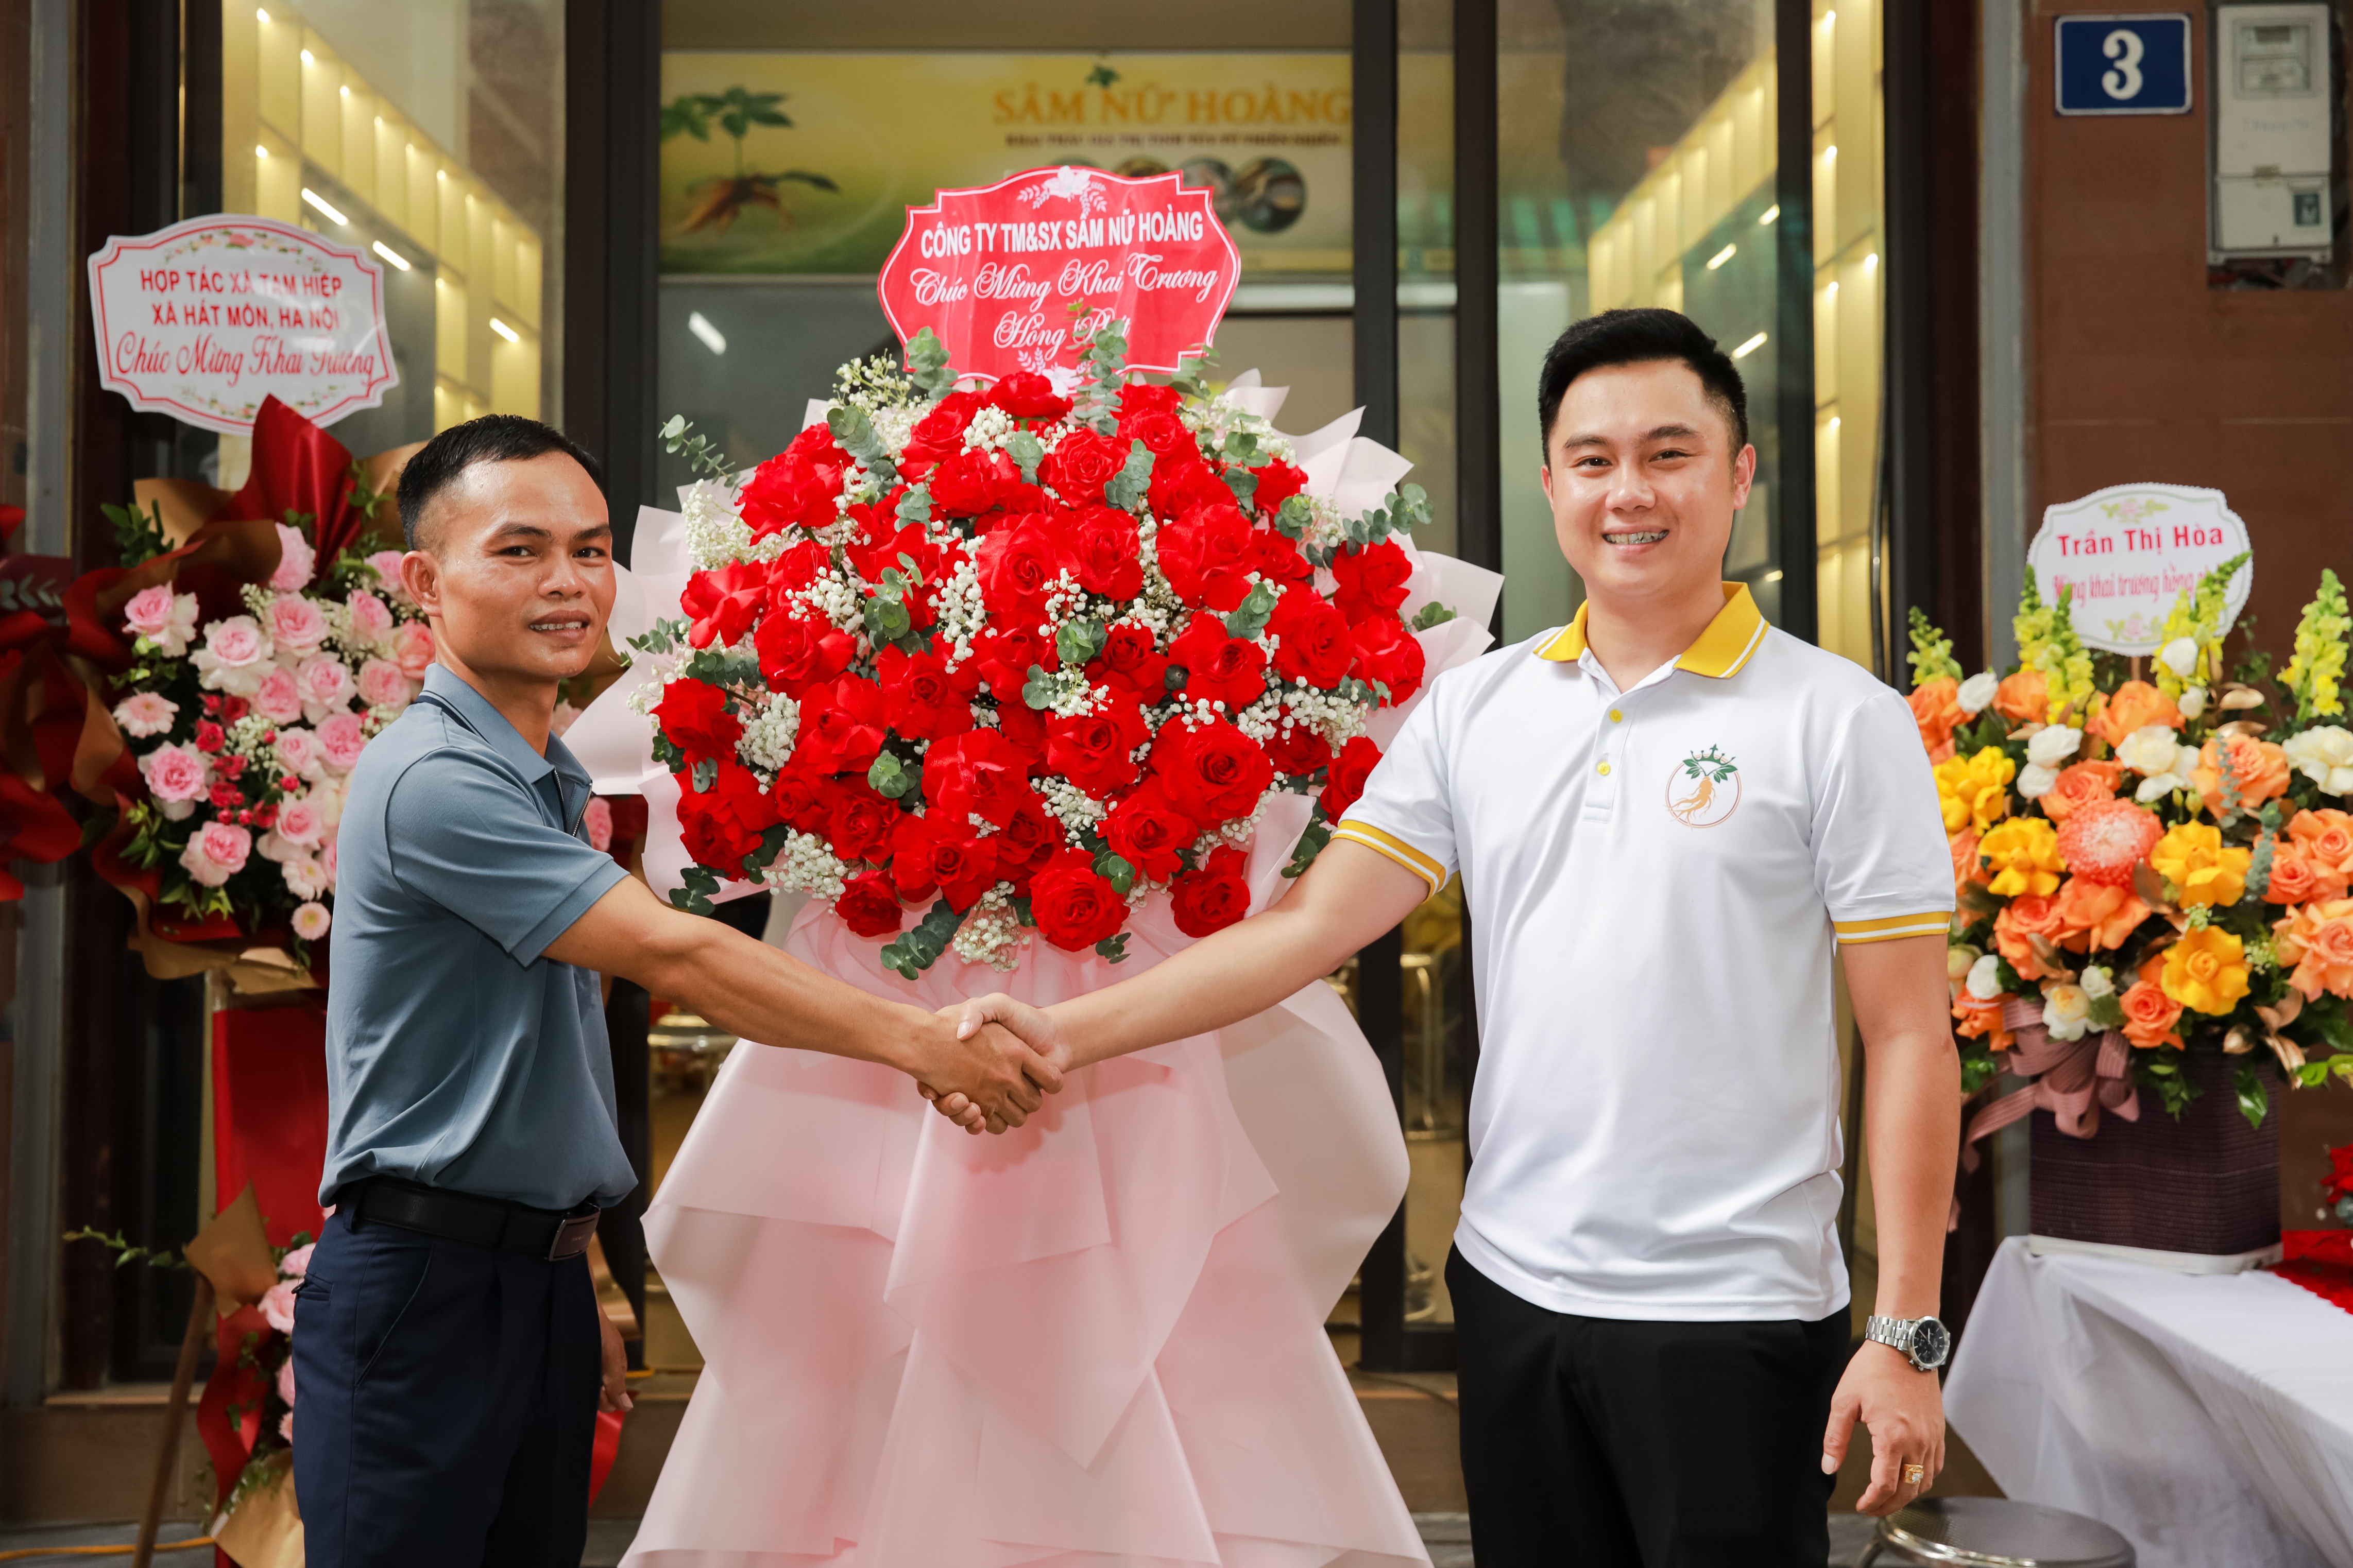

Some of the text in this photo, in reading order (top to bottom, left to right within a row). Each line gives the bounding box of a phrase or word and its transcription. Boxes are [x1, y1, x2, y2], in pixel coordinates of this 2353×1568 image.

[2102, 29, 2144, 100] 3
[1188, 82, 1352, 125] HOÀNG
[921, 204, 1203, 259] CÔNG TY TM&SX SÂM NỮ HOÀNG
[140, 269, 180, 294] HỢP
[186, 266, 224, 292] TÁC
[910, 252, 1219, 313] Chúc Mừng Khai Trương
[183, 299, 220, 325] HÁT
[994, 311, 1067, 361] Hồng
[116, 331, 171, 374] Chúc
[176, 333, 244, 387] Mừng
[249, 335, 303, 375] Khai
[2058, 522, 2223, 556] Trần Thị Hòa
